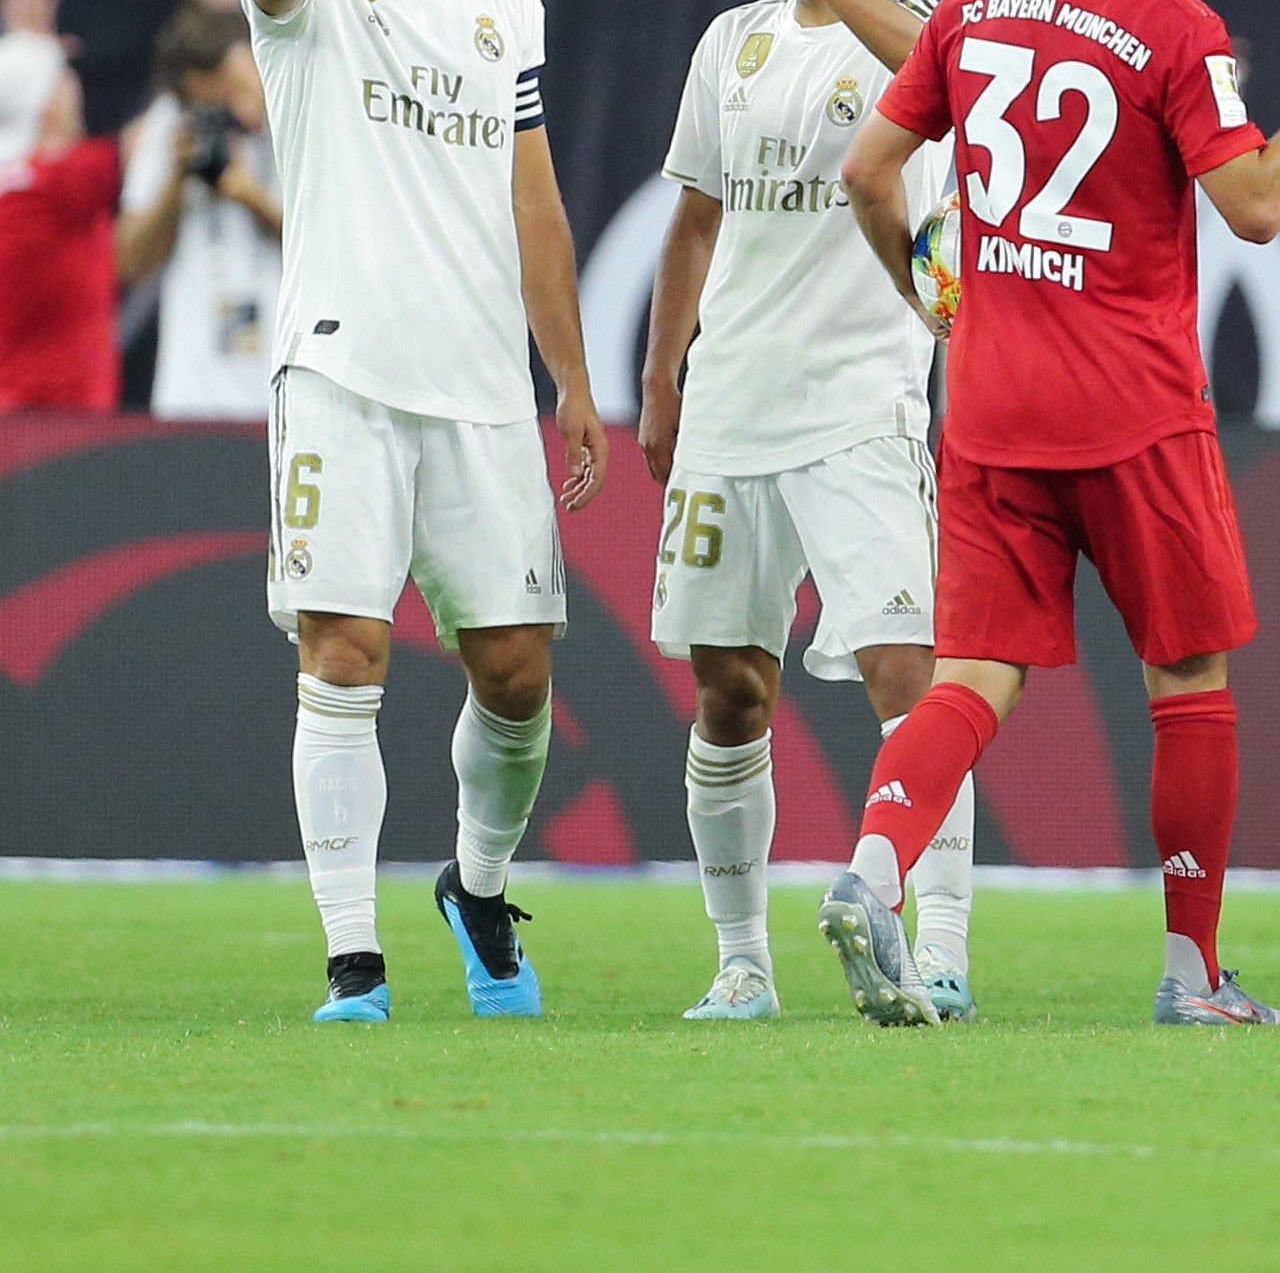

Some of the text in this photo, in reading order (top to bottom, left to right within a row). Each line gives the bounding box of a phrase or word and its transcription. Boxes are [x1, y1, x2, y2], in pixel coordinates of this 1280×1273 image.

[1055, 3, 1152, 72] MÜNCHEN
[410, 64, 463, 104] Fly
[757, 136, 806, 173] Fly
[958, 36, 1119, 252] 32
[284, 452, 324, 530] 6
[660, 487, 726, 569] 26
[881, 604, 921, 616] adidas
[704, 858, 758, 877] RMCF
